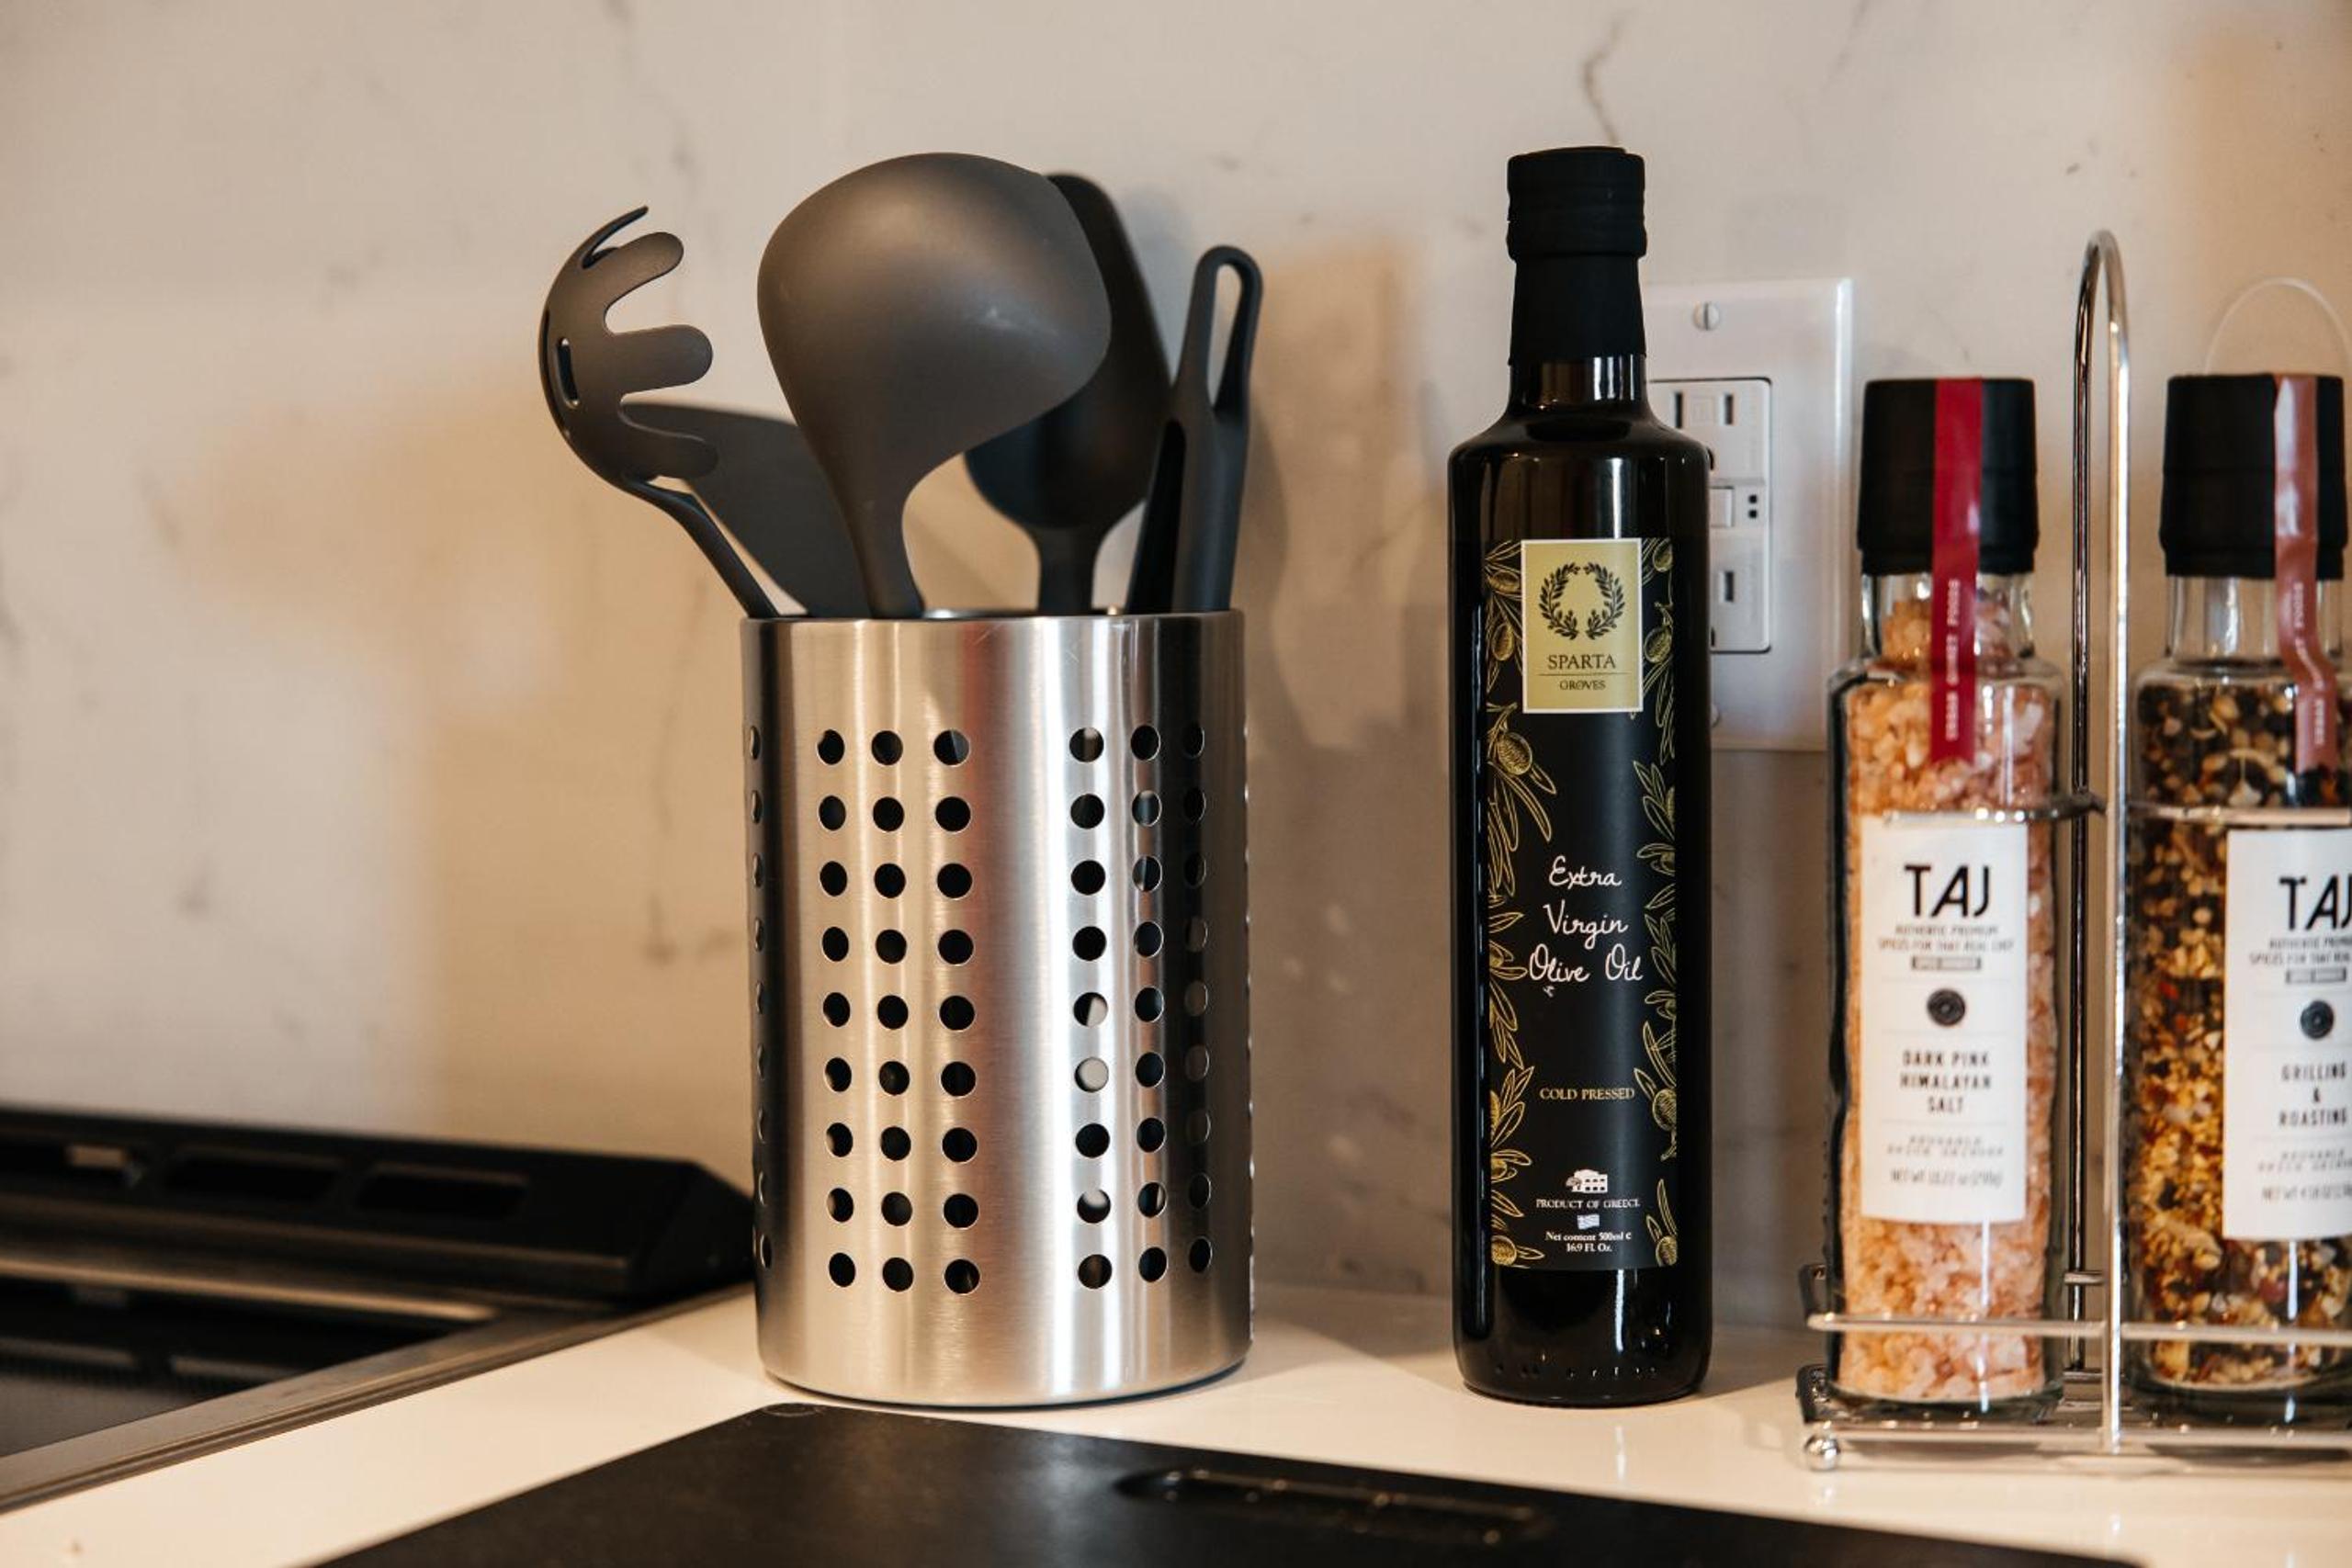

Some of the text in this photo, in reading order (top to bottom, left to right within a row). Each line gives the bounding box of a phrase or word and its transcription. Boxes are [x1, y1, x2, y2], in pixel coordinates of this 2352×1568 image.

[1547, 653, 1617, 670] SPARTA
[1559, 680, 1606, 691] GROVES
[1548, 855, 1623, 889] Extra
[1904, 864, 1990, 918] TAJ
[2278, 874, 2352, 931] TAJ
[1543, 899, 1629, 951] Virgin
[1529, 943, 1644, 982] Olive Oil
[1903, 1051, 1990, 1066] DARK PINK
[2281, 1062, 2346, 1080] GRILLING
[1900, 1074, 1992, 1089] HIMALAYAN
[1540, 1088, 1635, 1100] COLD PRESSED
[1927, 1097, 1963, 1113] SALT
[2279, 1108, 2347, 1125] ROASTING
[1536, 1198, 1640, 1209] PRODUCT OF GREECE
[1544, 1231, 1561, 1241] Net
